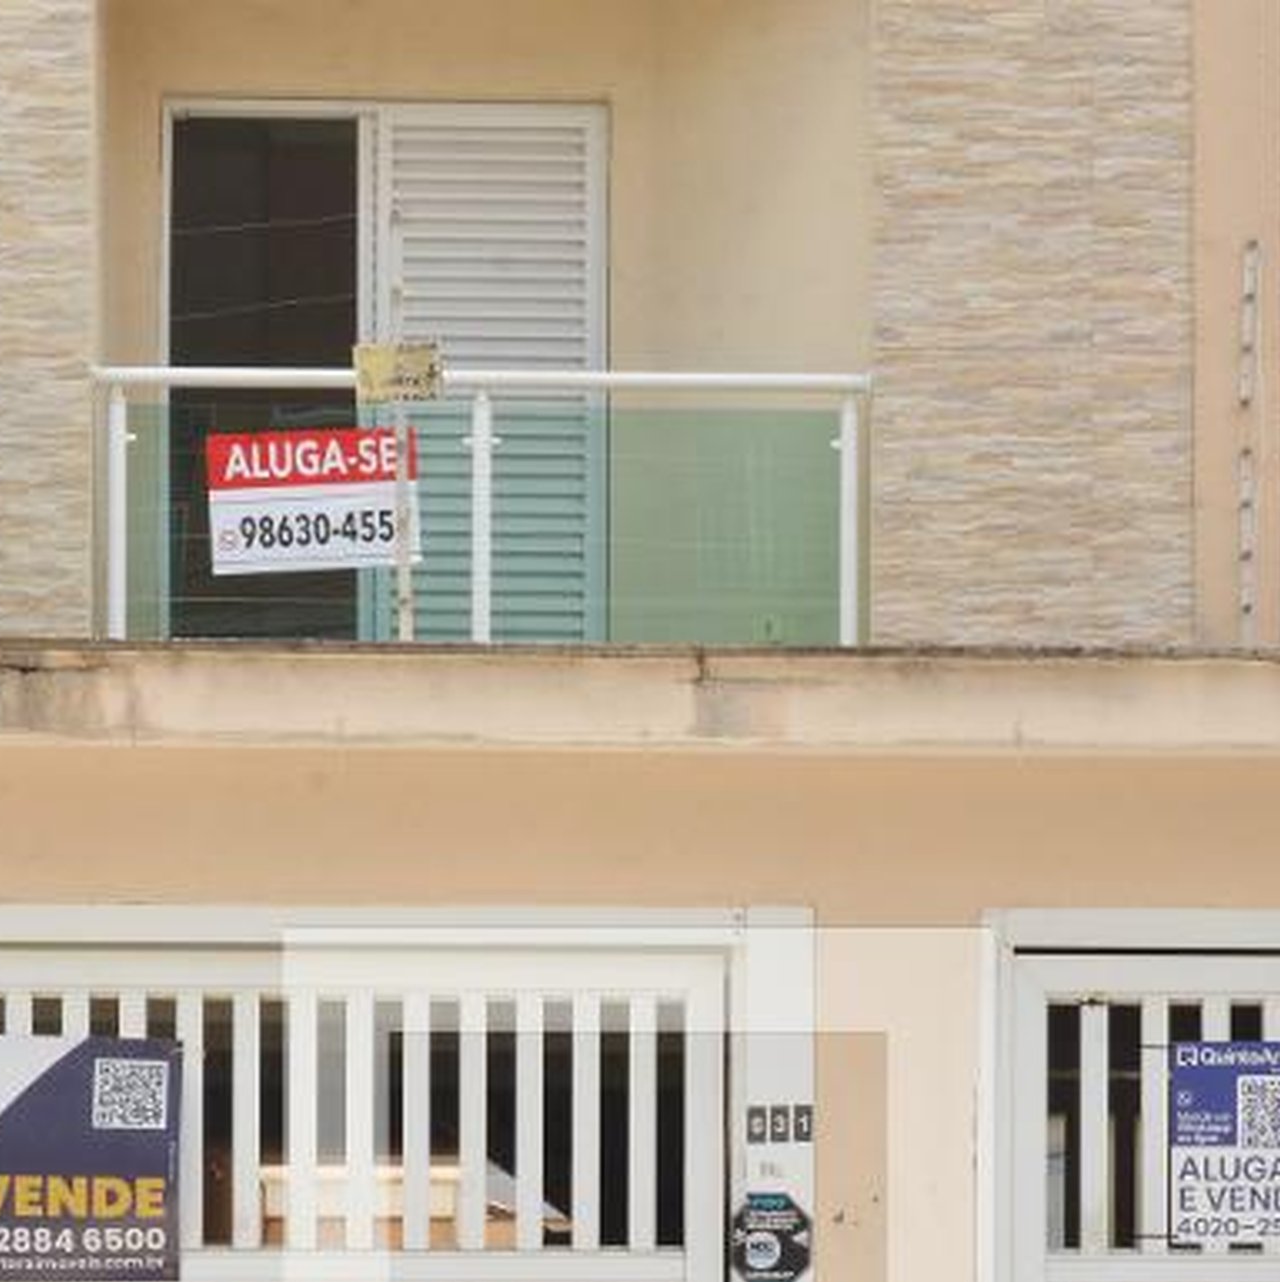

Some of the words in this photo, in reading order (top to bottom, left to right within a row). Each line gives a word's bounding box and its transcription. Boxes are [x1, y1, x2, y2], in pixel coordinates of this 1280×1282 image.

[223, 436, 397, 482] ALUGA-SE
[239, 509, 396, 549] 98630-455
[1179, 1186, 1197, 1212] E
[82, 1226, 167, 1251] 6500
